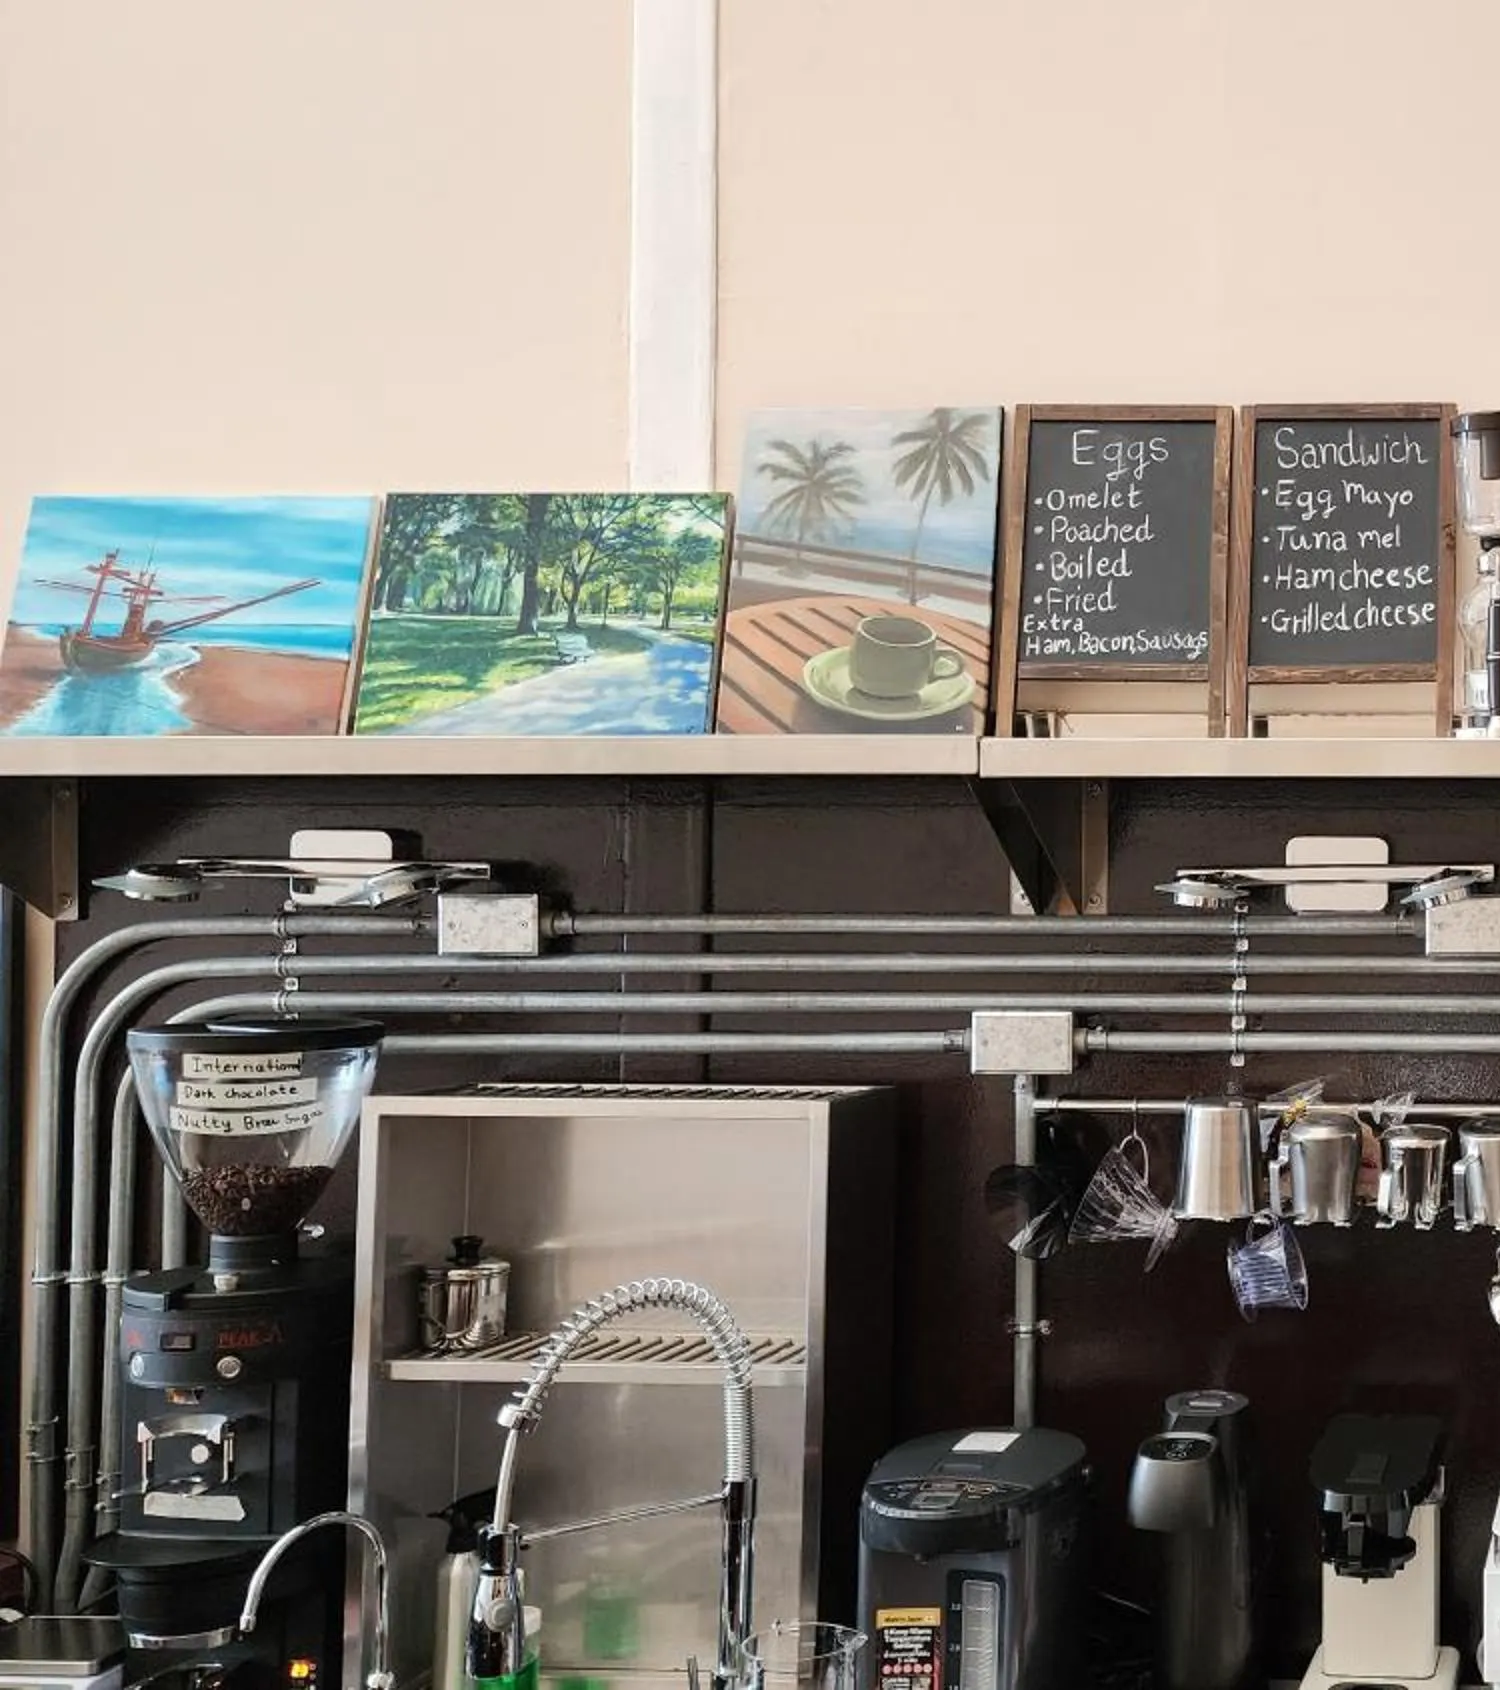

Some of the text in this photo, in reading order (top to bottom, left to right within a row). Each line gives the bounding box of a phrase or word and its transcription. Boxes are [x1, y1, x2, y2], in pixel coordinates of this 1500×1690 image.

[1073, 429, 1169, 481] Eggs
[1275, 427, 1428, 469] Sandwich
[1047, 482, 1143, 511] Omelet
[1275, 479, 1336, 521] Egg
[1051, 514, 1154, 543] Poached
[1276, 525, 1348, 551] Tuna
[1050, 546, 1132, 581] Boiled
[1046, 579, 1117, 614] Fried
[1023, 613, 1084, 633] Extra
[1271, 597, 1436, 635] Grilled cheese
[184, 1086, 216, 1099] Dark
[178, 1114, 233, 1133] Nutty
